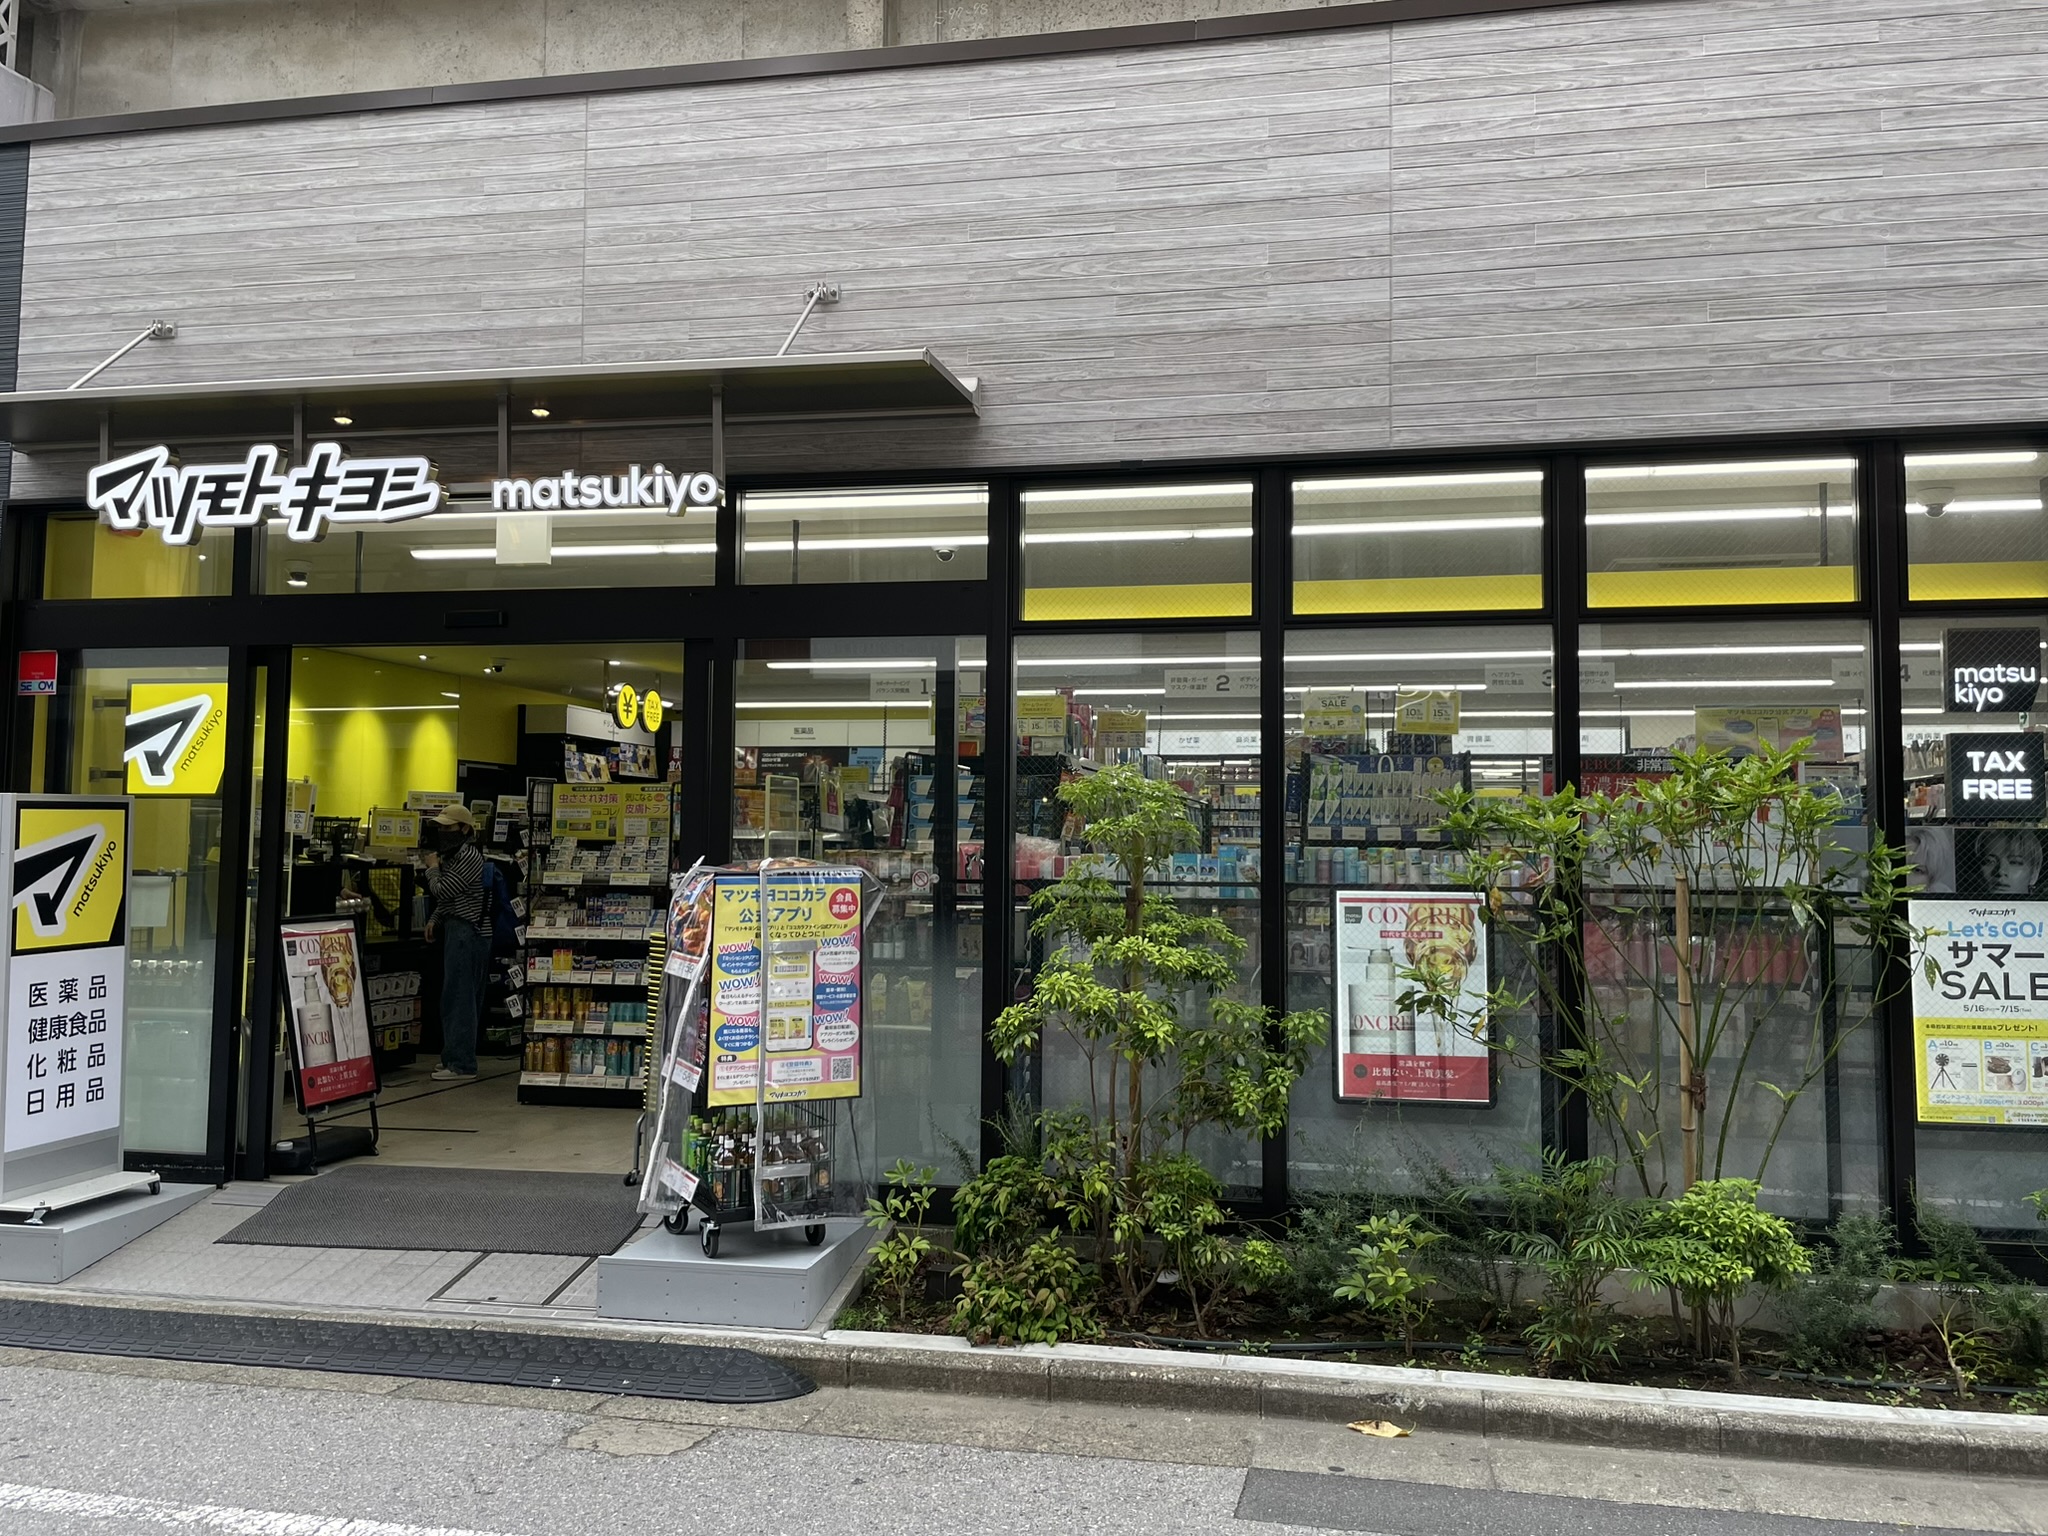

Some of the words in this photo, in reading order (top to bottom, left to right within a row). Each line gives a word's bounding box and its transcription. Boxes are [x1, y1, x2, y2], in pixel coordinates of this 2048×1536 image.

[89, 444, 440, 545] マツモトキヨシ
[492, 463, 718, 516] matsukiyo
[1216, 675, 1230, 691] 2
[1954, 664, 2036, 683] matsu
[20, 681, 54, 691] SEOM
[921, 679, 929, 694] 1
[647, 699, 659, 710] TAX
[1321, 699, 1347, 708] SALE
[1954, 684, 2004, 712] kiyo
[646, 711, 660, 723] FREE
[180, 708, 223, 771] matsukiyo
[1966, 751, 2026, 772] TAX
[558, 793, 619, 804] 虫さされ対策
[1962, 778, 2033, 800] FREE
[73, 840, 117, 917] matsukiyo
[835, 893, 852, 902] 会員
[832, 904, 856, 914] 募集中
[1948, 921, 1999, 938] Let's
[2002, 921, 2043, 938] GO!
[1948, 941, 2045, 969] サマー
[29, 975, 107, 1008] 医薬品
[1941, 970, 2048, 1001] SALE
[28, 1009, 106, 1044] 健康食品
[27, 1043, 106, 1080] 化粧品
[27, 1077, 105, 1115] 日用品
